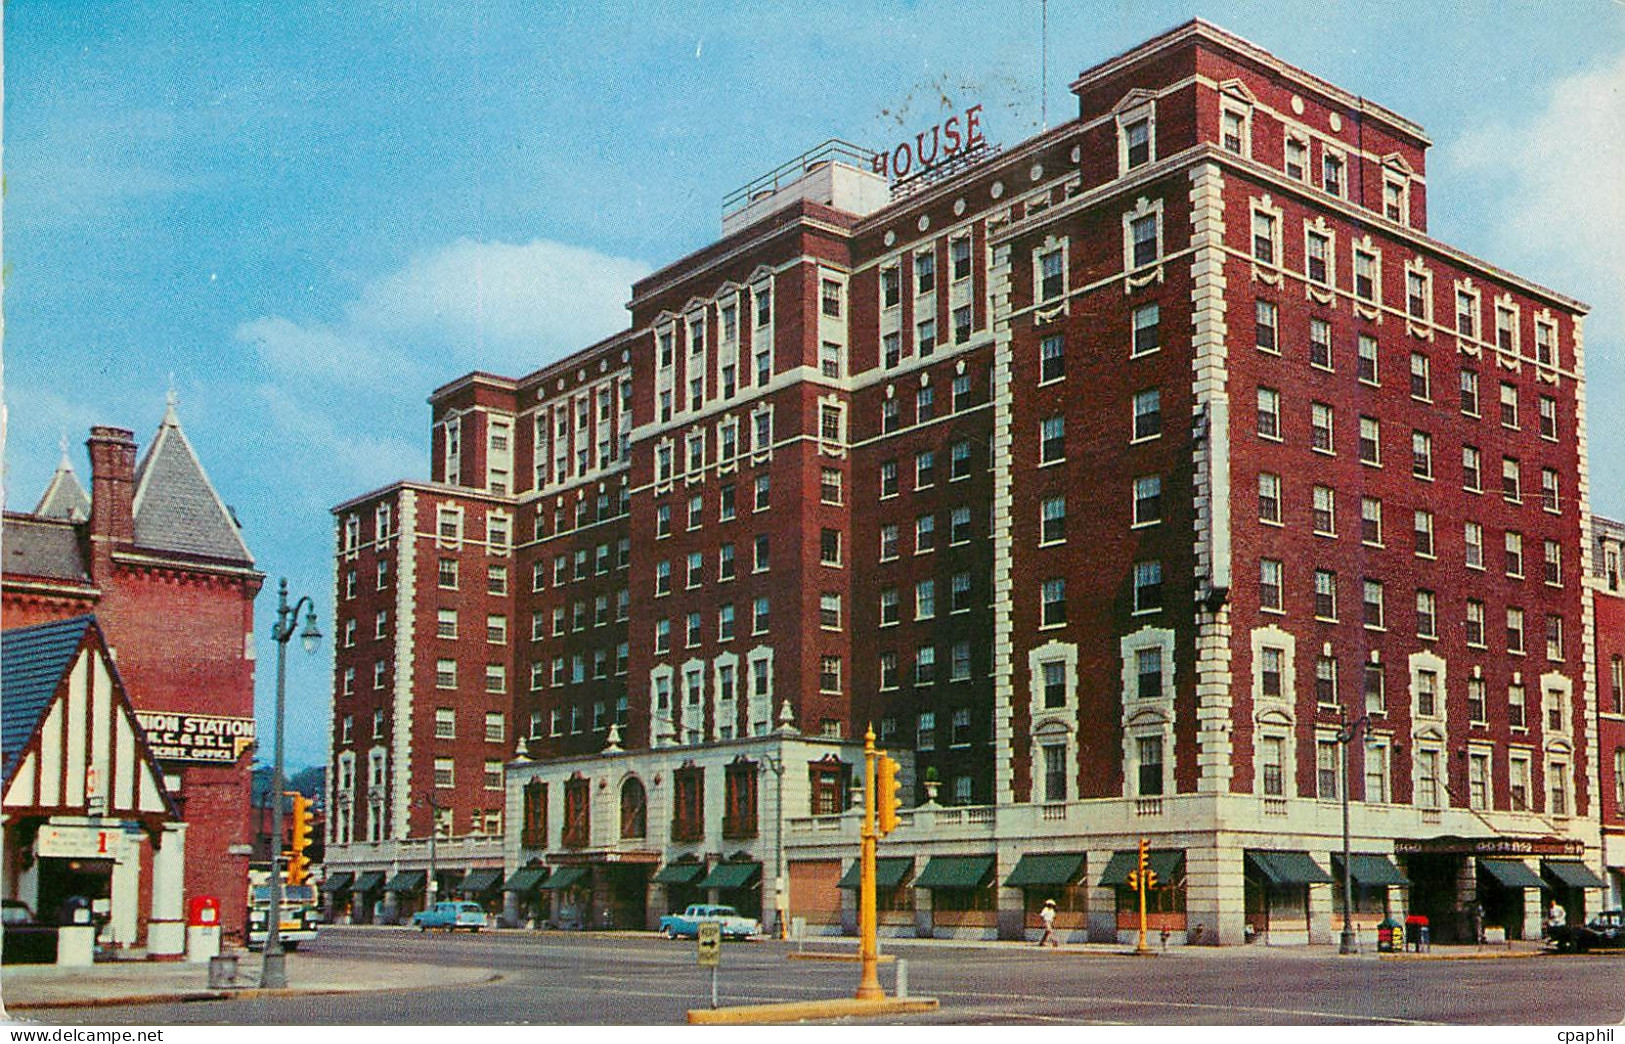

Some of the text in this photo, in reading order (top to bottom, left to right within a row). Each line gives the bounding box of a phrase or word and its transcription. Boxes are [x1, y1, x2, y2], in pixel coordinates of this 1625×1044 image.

[872, 103, 983, 178] HOUSE
[136, 714, 254, 737] NION STATION
